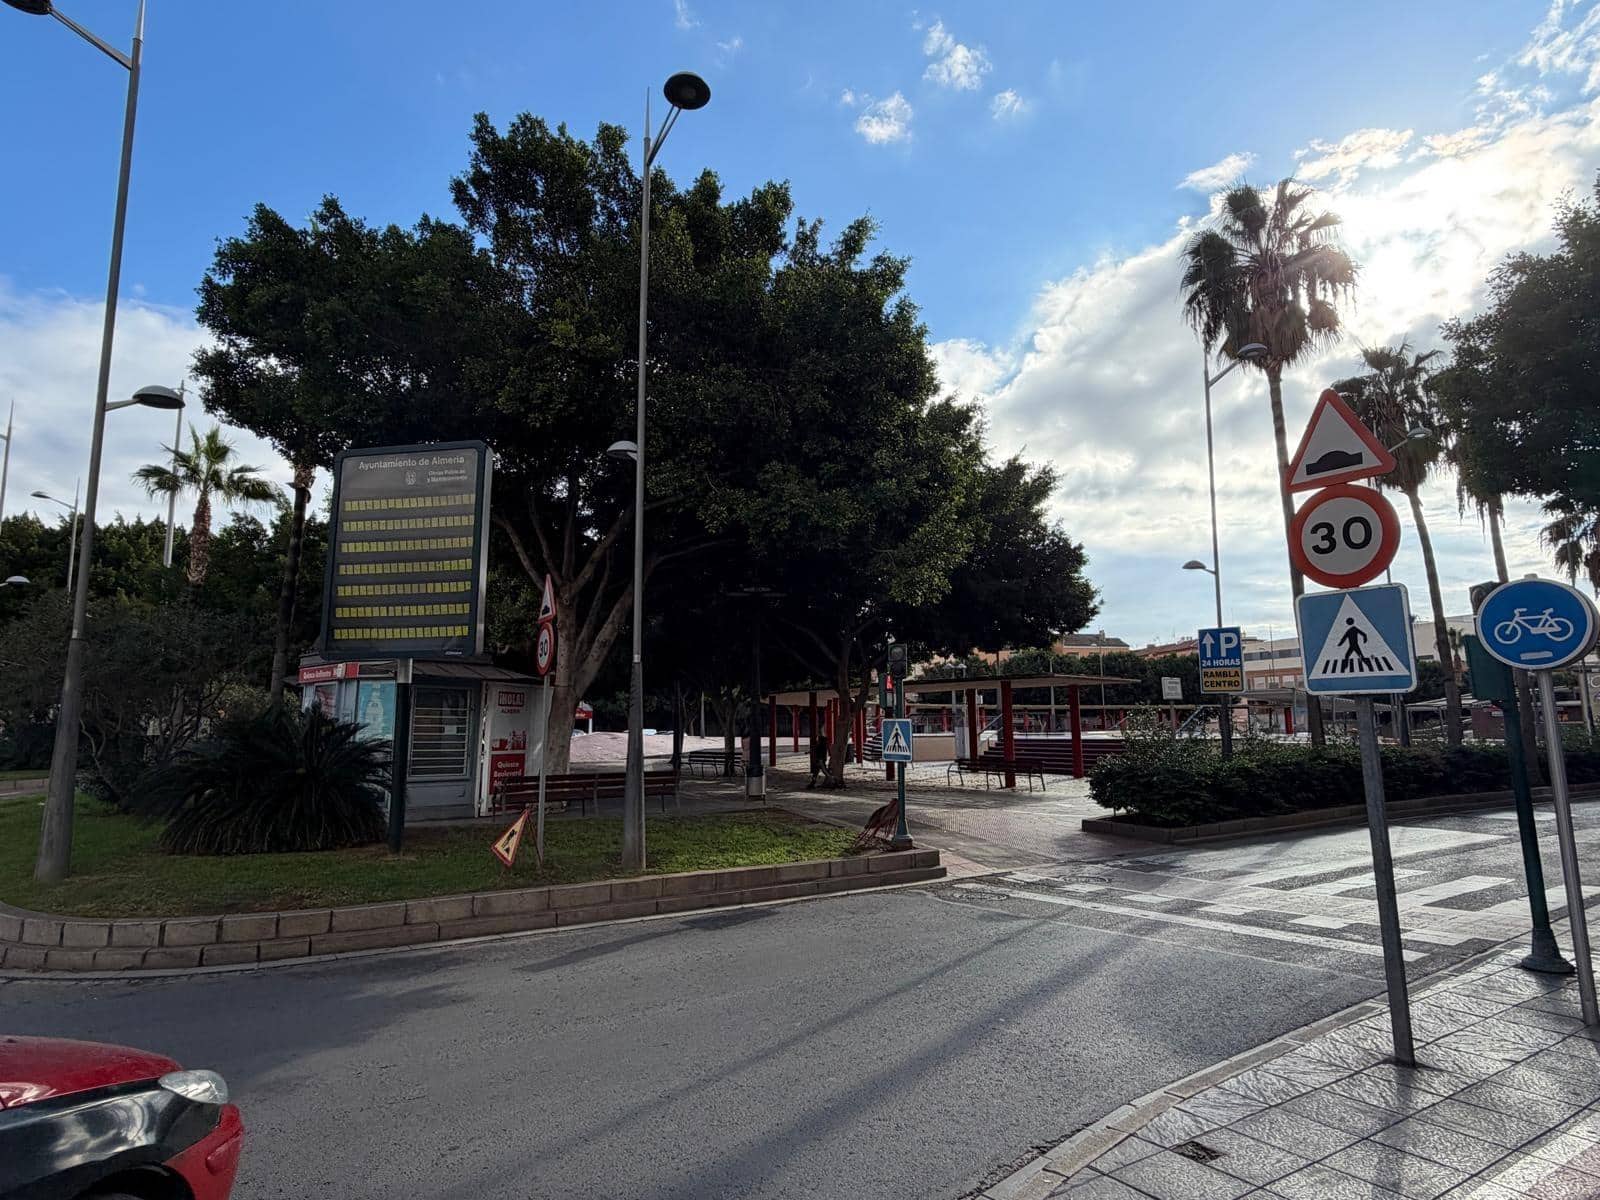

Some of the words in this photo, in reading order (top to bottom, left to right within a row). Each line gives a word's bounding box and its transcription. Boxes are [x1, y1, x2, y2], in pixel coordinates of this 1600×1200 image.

[359, 458, 417, 471] Ayuntamiento
[418, 458, 430, 466] de
[1310, 516, 1372, 555] 30
[539, 638, 548, 658] 30
[1219, 632, 1239, 658] P
[1201, 659, 1211, 667] 24
[1213, 658, 1241, 667] HORAS
[1203, 670, 1240, 679] RAMBLA
[1204, 680, 1240, 688] CENTRO
